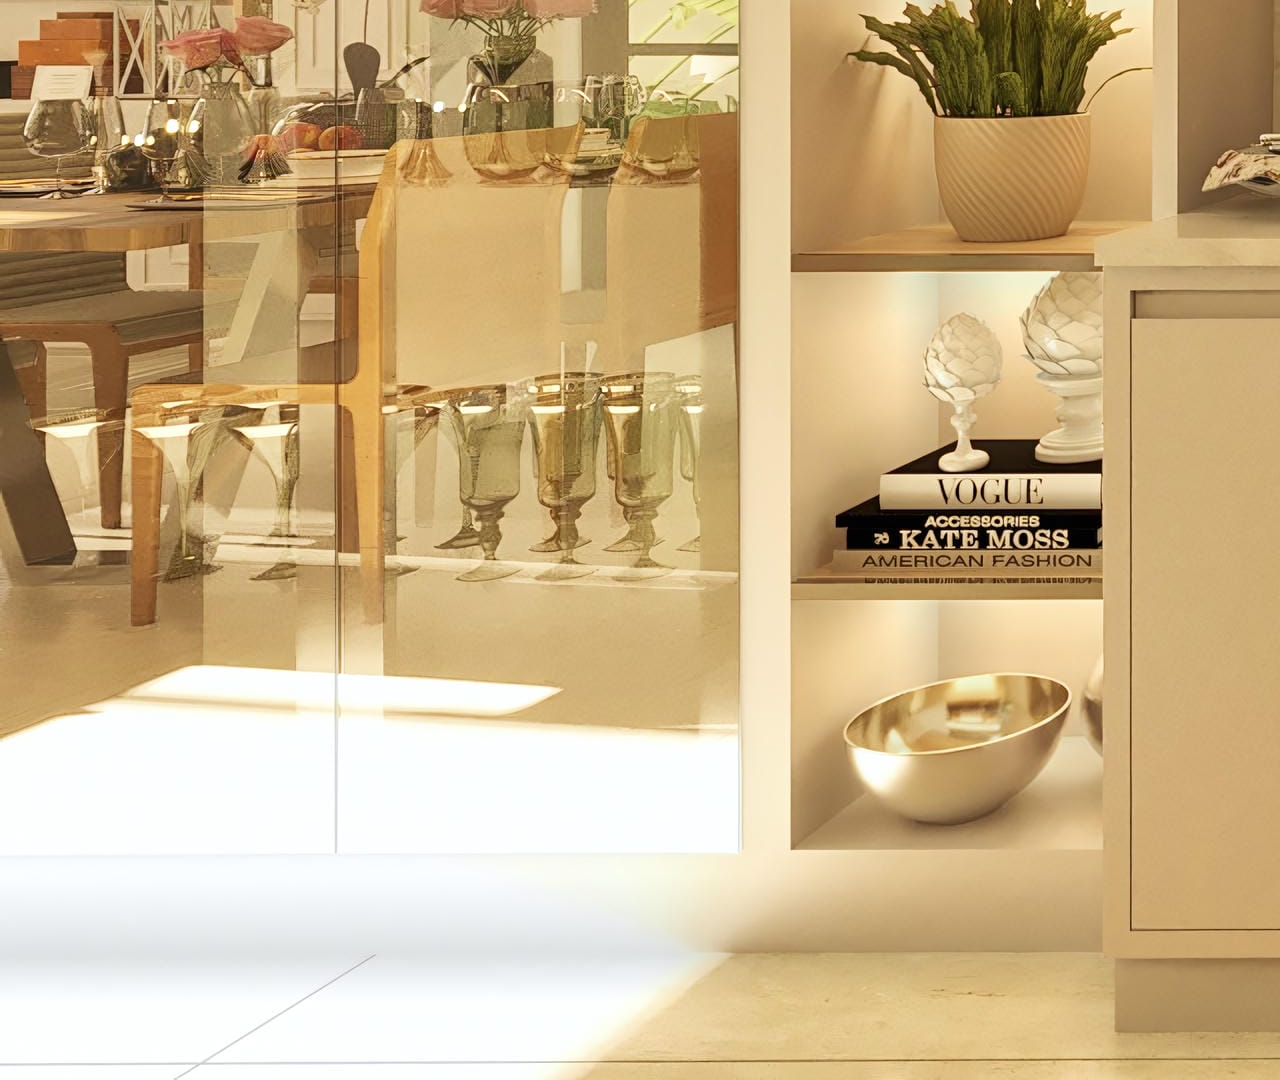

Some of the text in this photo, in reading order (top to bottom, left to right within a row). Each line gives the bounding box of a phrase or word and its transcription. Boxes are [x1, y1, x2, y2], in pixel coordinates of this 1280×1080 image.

[936, 478, 1044, 505] VOGUE
[924, 515, 1040, 528] ACCESSORIES
[899, 529, 979, 549] KATE
[986, 529, 1070, 549] MOSS
[861, 554, 1093, 568] AMERICAN FASHION
